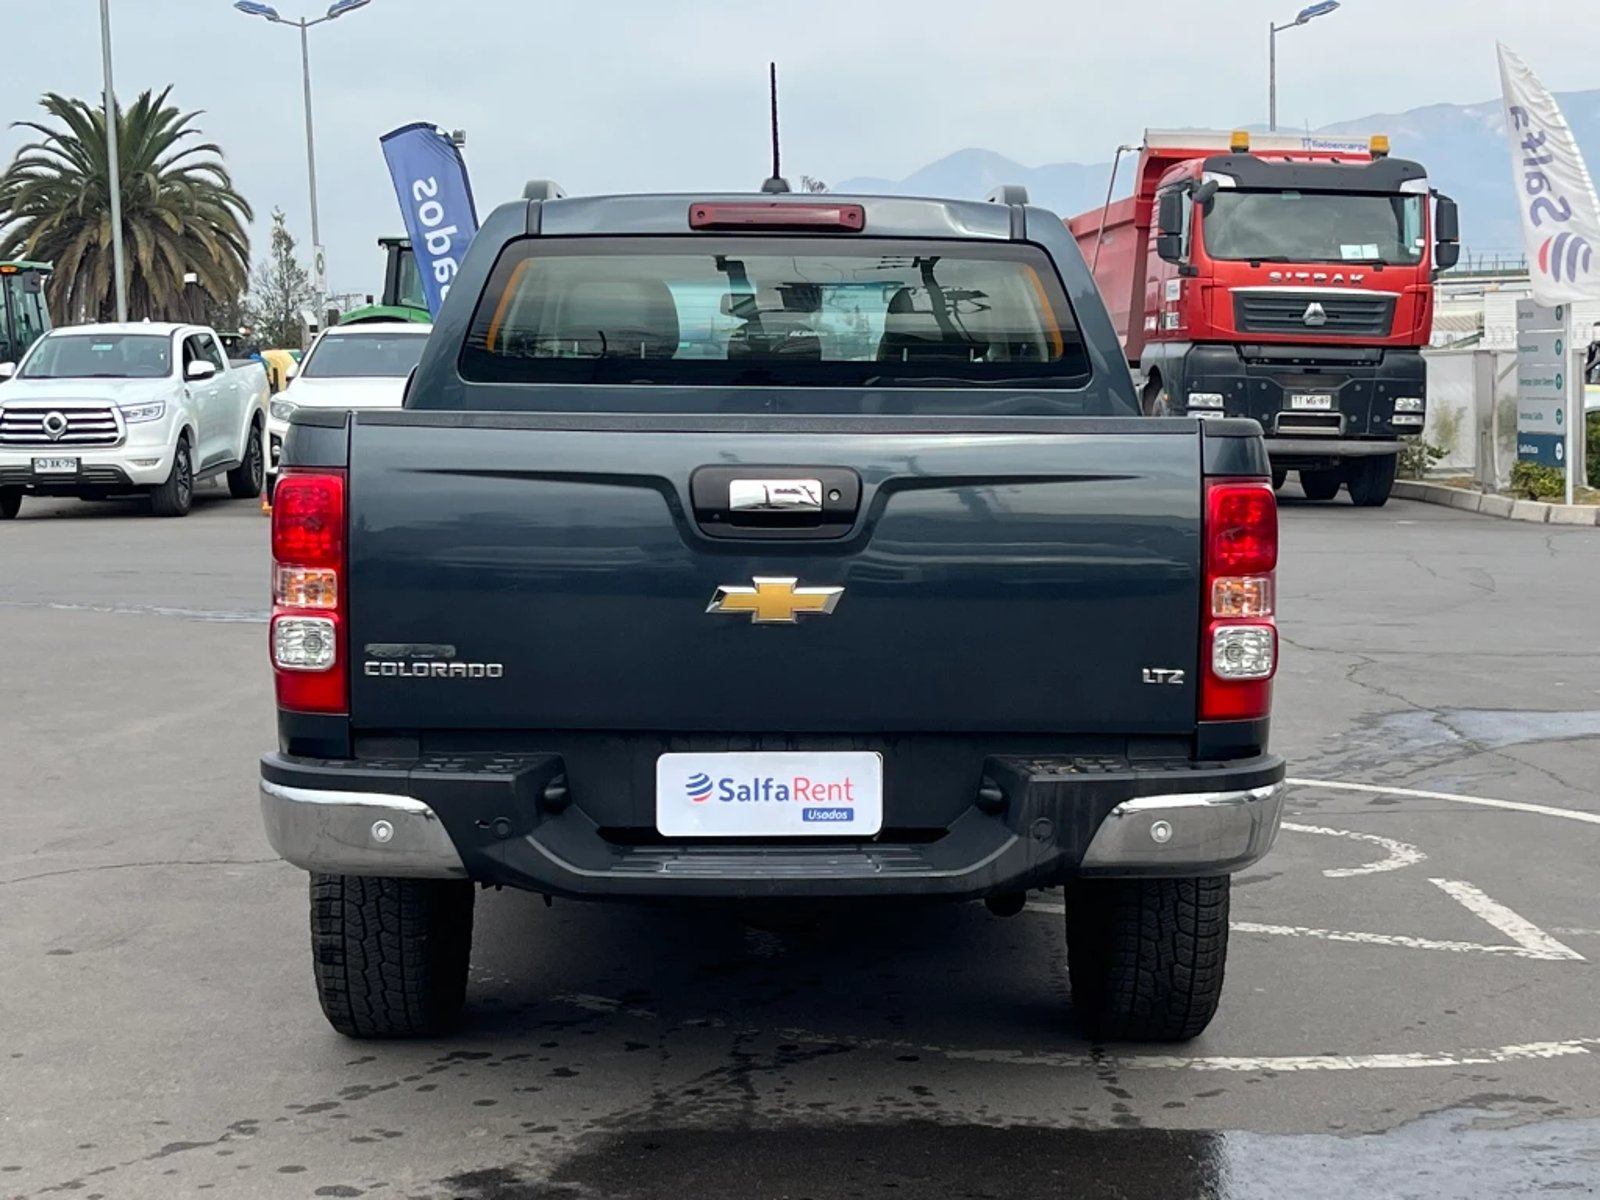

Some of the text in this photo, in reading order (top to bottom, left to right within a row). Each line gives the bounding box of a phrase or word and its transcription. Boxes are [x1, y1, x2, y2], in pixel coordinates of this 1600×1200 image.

[1269, 271, 1364, 287] SITRAK
[364, 661, 503, 678] COLORADO
[1142, 668, 1185, 684] LTZ
[718, 777, 854, 802] SalfaRent
[808, 809, 848, 820] Usados
